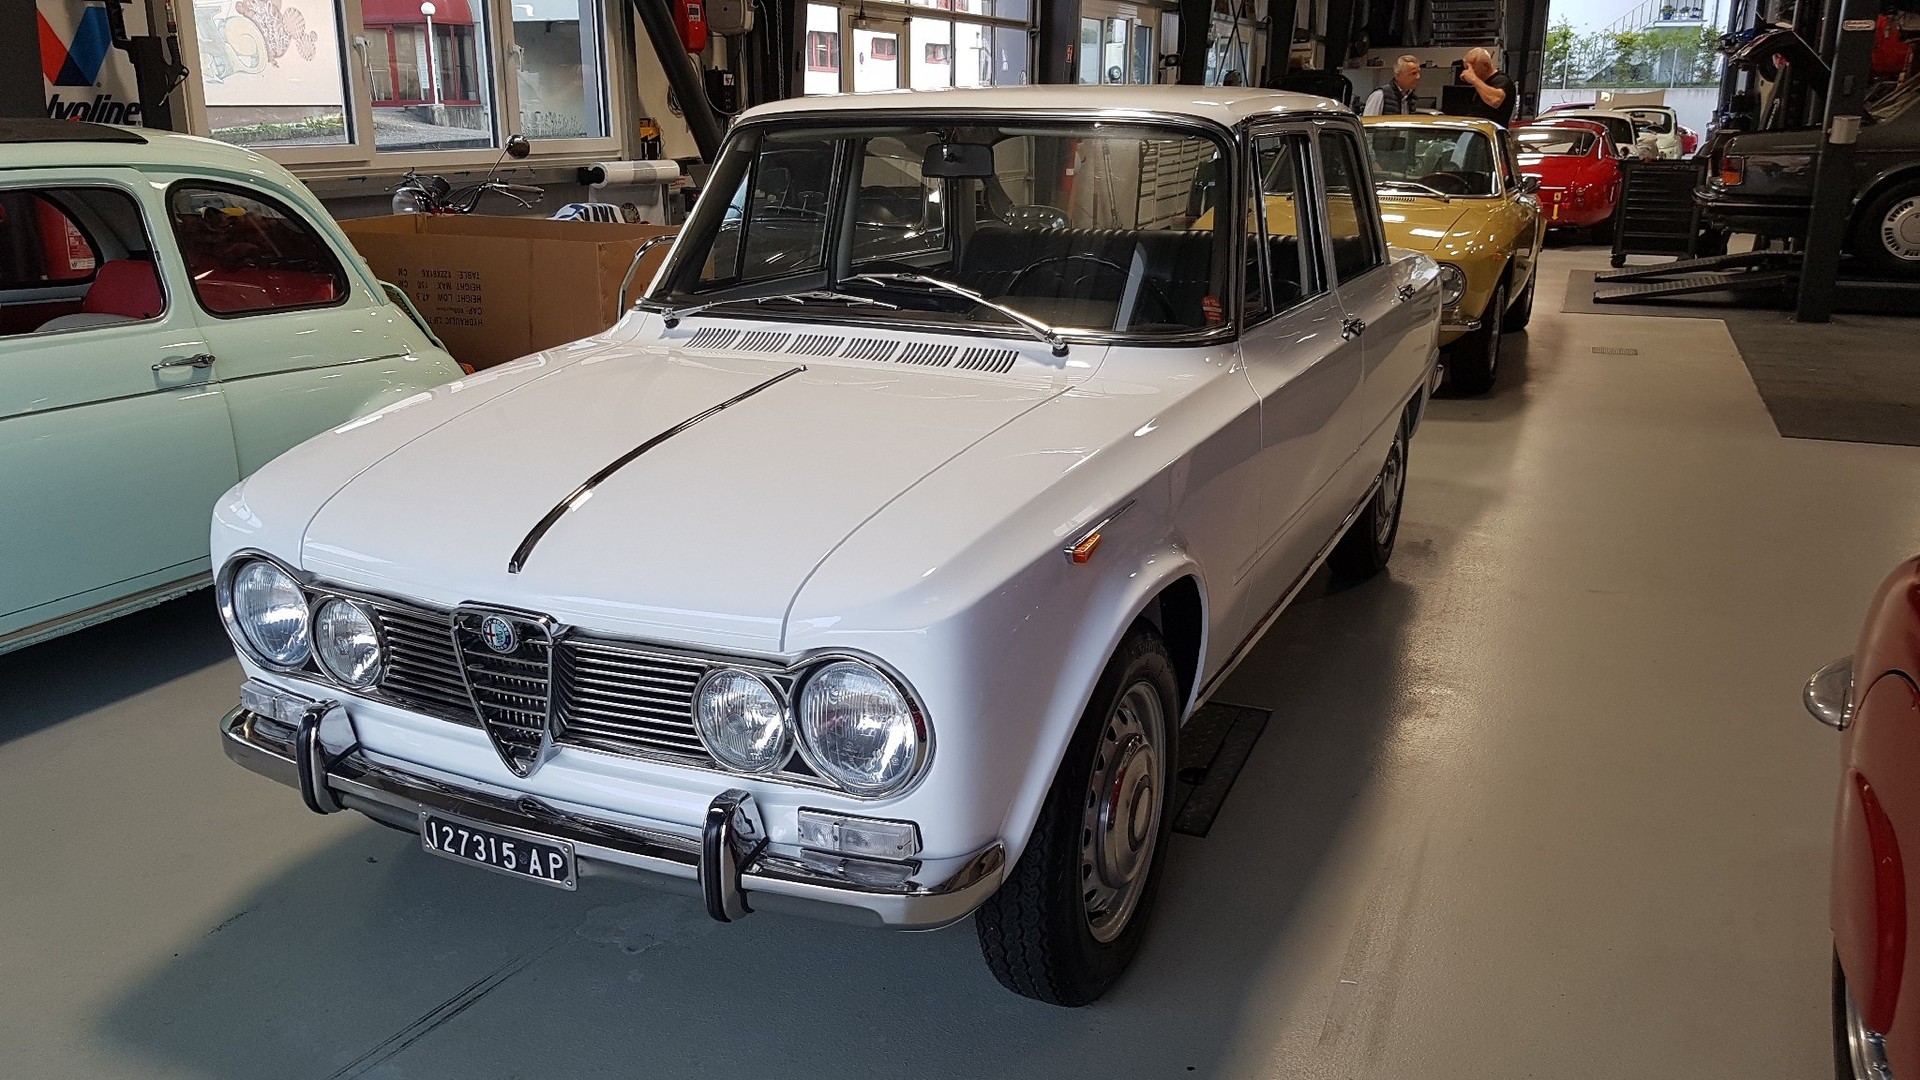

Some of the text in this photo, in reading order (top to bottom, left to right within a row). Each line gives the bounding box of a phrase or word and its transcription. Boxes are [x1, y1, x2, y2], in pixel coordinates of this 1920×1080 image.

[397, 268, 408, 276] CM
[437, 281, 452, 290] MAX
[457, 282, 482, 291] HEIGHT
[437, 293, 453, 302] LOW
[457, 294, 482, 303] HEIGHT
[446, 317, 484, 327] HYDRAULIC
[430, 821, 563, 879] 127315 AP
